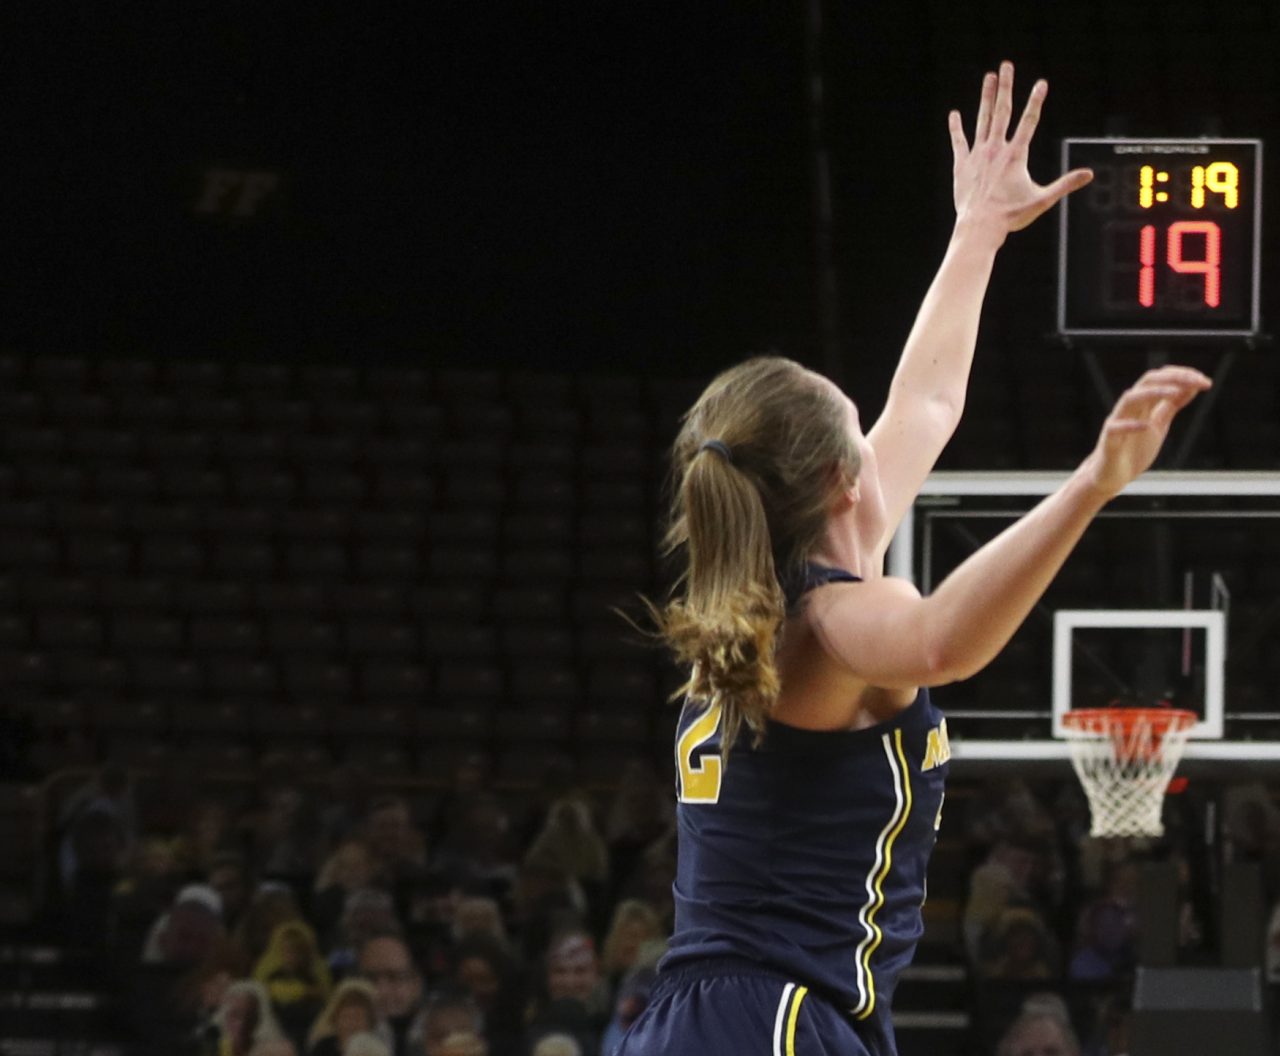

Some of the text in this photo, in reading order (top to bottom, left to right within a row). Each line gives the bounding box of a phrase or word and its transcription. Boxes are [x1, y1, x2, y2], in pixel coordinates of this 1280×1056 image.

[1139, 161, 1239, 209] 1:19
[1138, 221, 1222, 308] 19
[675, 690, 723, 804] 2
